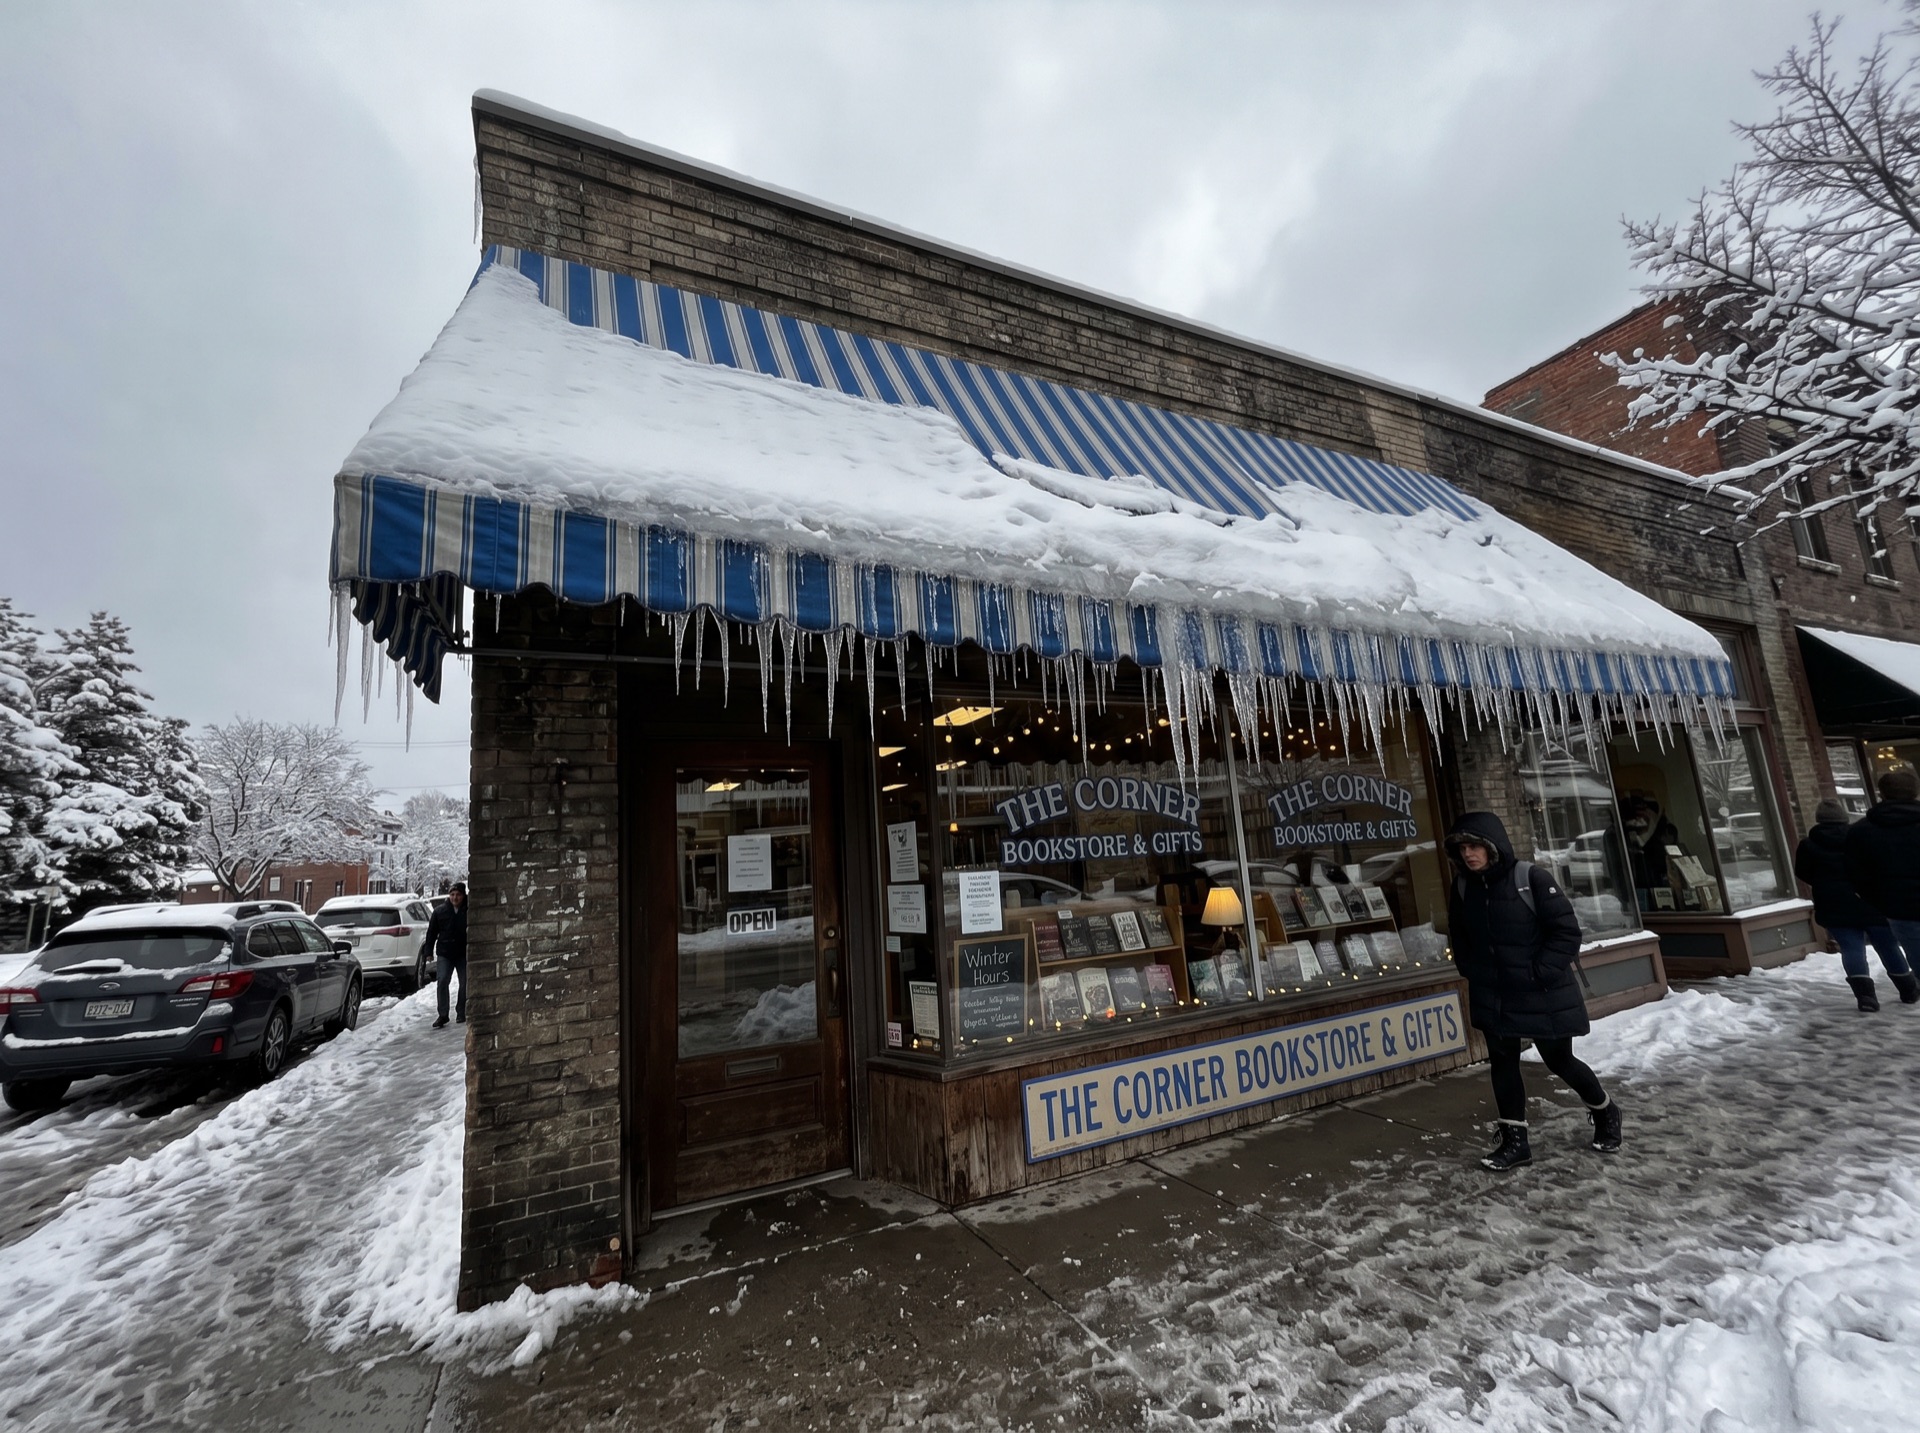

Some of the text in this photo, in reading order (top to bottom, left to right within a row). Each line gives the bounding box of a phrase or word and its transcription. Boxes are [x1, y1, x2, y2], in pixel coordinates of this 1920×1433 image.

[996, 777, 1200, 833] THE CORNER
[1267, 774, 1412, 823] THE CORNER
[1002, 830, 1203, 864] BOOKSTORE & GIFTS
[1274, 819, 1418, 846] BOOKSTORE & GIFTS
[729, 910, 774, 934] OPEN
[964, 945, 1014, 969] Winter
[973, 969, 1010, 986] Hours
[1039, 1003, 1459, 1142] THE CORNER BOOKSTORE & GIFTS
